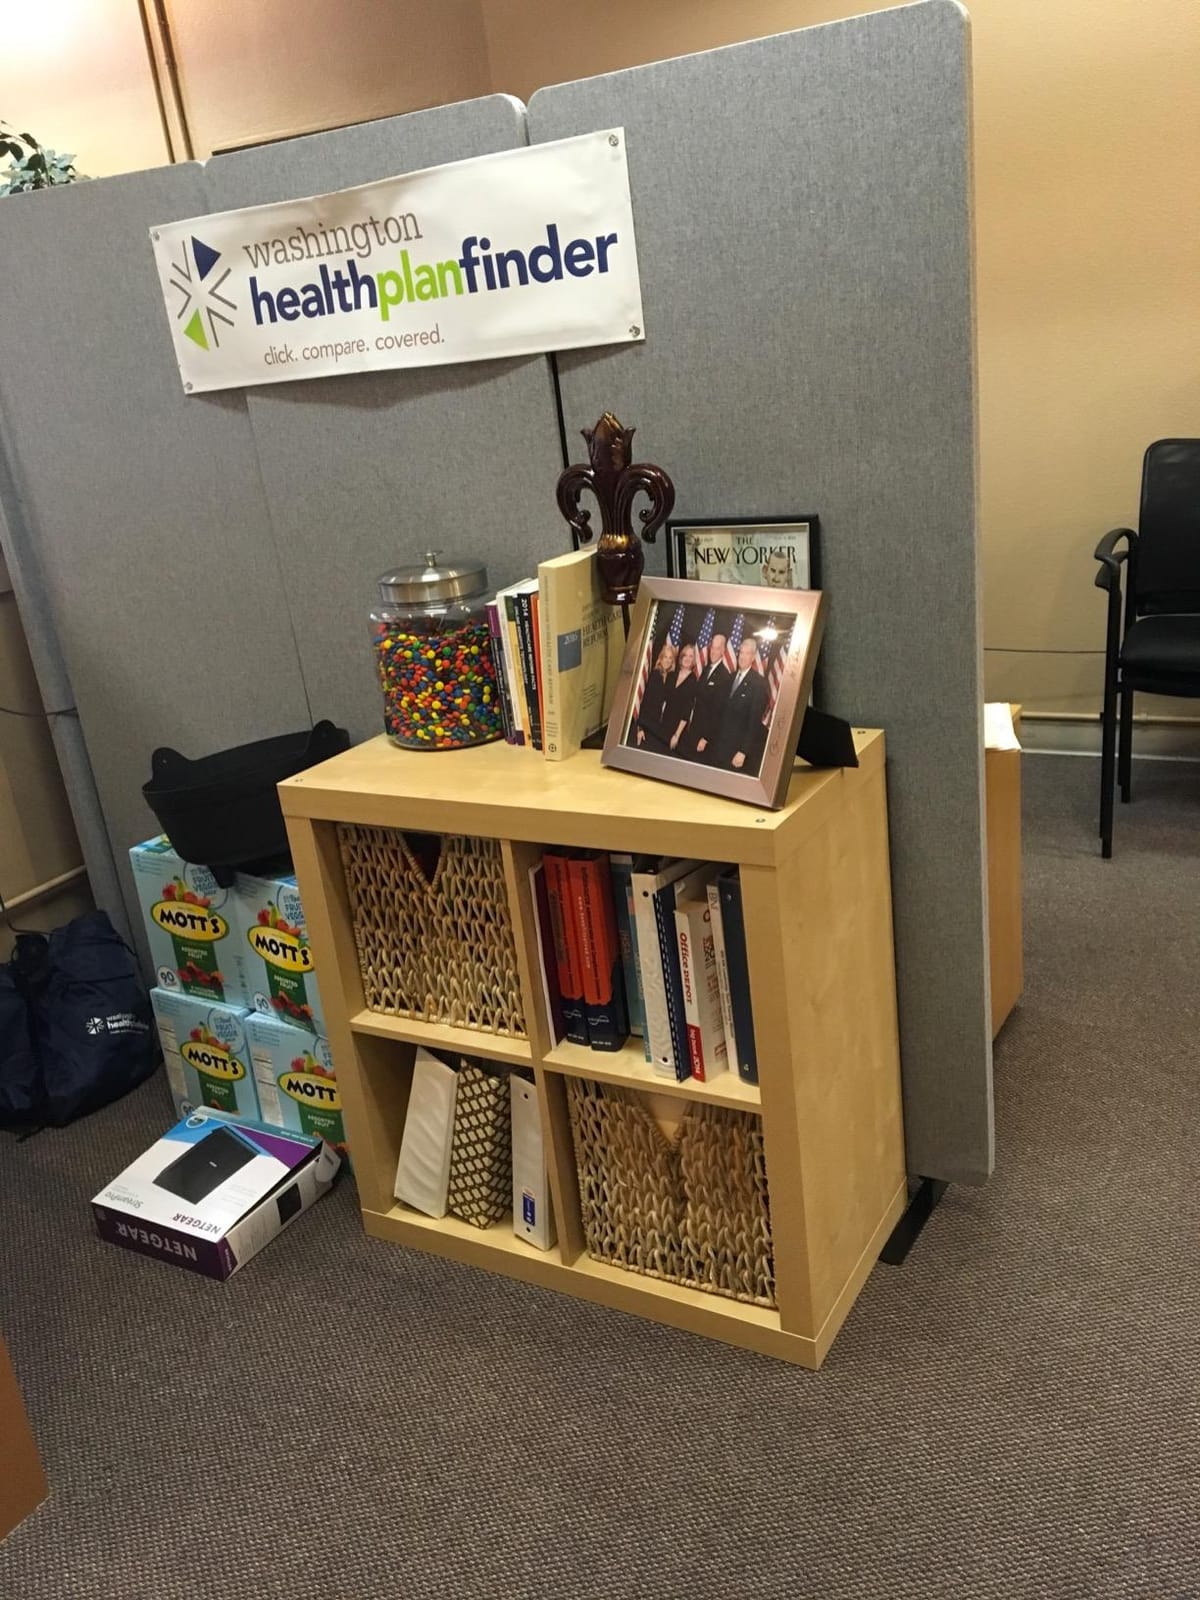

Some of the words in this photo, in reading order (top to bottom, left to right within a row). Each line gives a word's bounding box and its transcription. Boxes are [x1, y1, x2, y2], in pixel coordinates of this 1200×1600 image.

[242, 212, 423, 269] washington
[249, 224, 618, 325] healthplanfinder
[264, 343, 298, 365] click.
[302, 338, 369, 362] compare.
[375, 323, 445, 351] covered.
[694, 547, 730, 565] NEW
[521, 598, 529, 616] 2014
[679, 931, 689, 970] Office
[160, 971, 175, 983] 90
[683, 970, 693, 1005] DEPOT
[256, 998, 269, 1010] 90
[286, 1078, 337, 1102] MOTT
[172, 1213, 221, 1234] NETGEAR
[116, 1222, 198, 1261] NETGEAR
